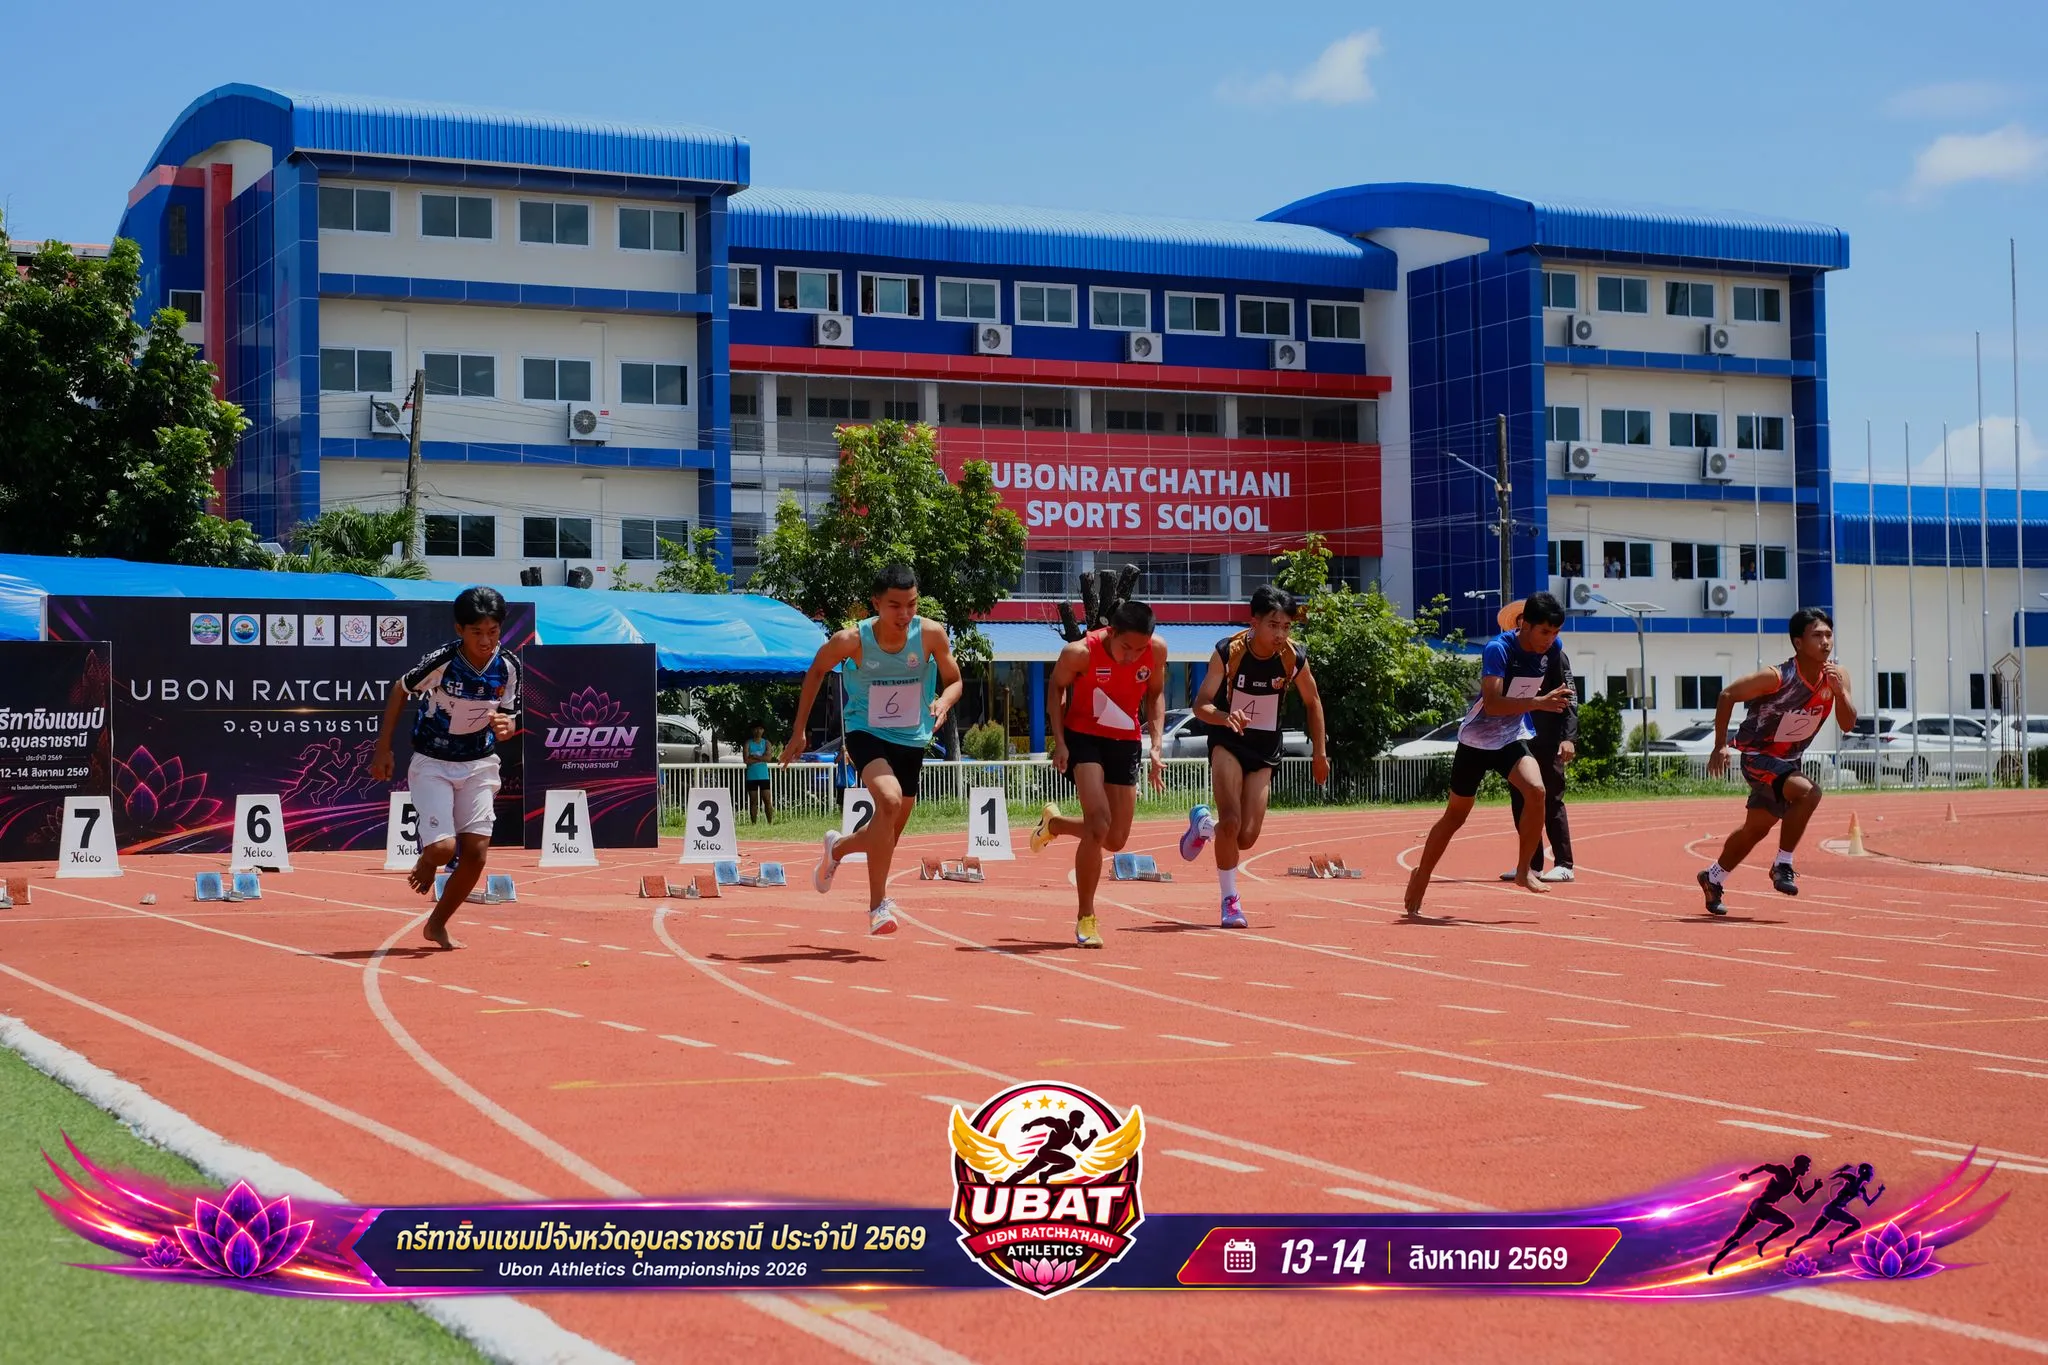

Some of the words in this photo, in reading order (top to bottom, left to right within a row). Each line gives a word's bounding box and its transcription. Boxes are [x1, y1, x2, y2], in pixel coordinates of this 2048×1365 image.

[991, 461, 1290, 497] UBONRATCHATHANI
[1027, 500, 1141, 530] SPORTS
[1157, 503, 1270, 533] SCHOOL
[130, 679, 234, 701] UBON
[252, 679, 434, 701] RATCHAT
[885, 691, 899, 715] 6
[1242, 700, 1261, 720] 4
[223, 715, 379, 738] จ.อุบลราชธานี
[467, 707, 488, 728] 7
[1785, 718, 1810, 737] 2
[544, 726, 640, 748] UBON
[546, 747, 636, 760] ATHLETICS
[31, 767, 64, 778] สิงหาคม
[66, 767, 89, 777] 2569
[246, 804, 272, 844] 6
[400, 803, 420, 842] 5
[555, 802, 579, 841] 4
[696, 799, 721, 838] 3
[980, 797, 997, 835] 1
[73, 808, 101, 849] 7
[243, 846, 273, 858] Nelco
[396, 844, 420, 855] Nelc
[552, 842, 580, 854] Nelco
[693, 839, 721, 851] Nelco
[975, 835, 1000, 848] Nelco
[70, 851, 102, 863] Nelco
